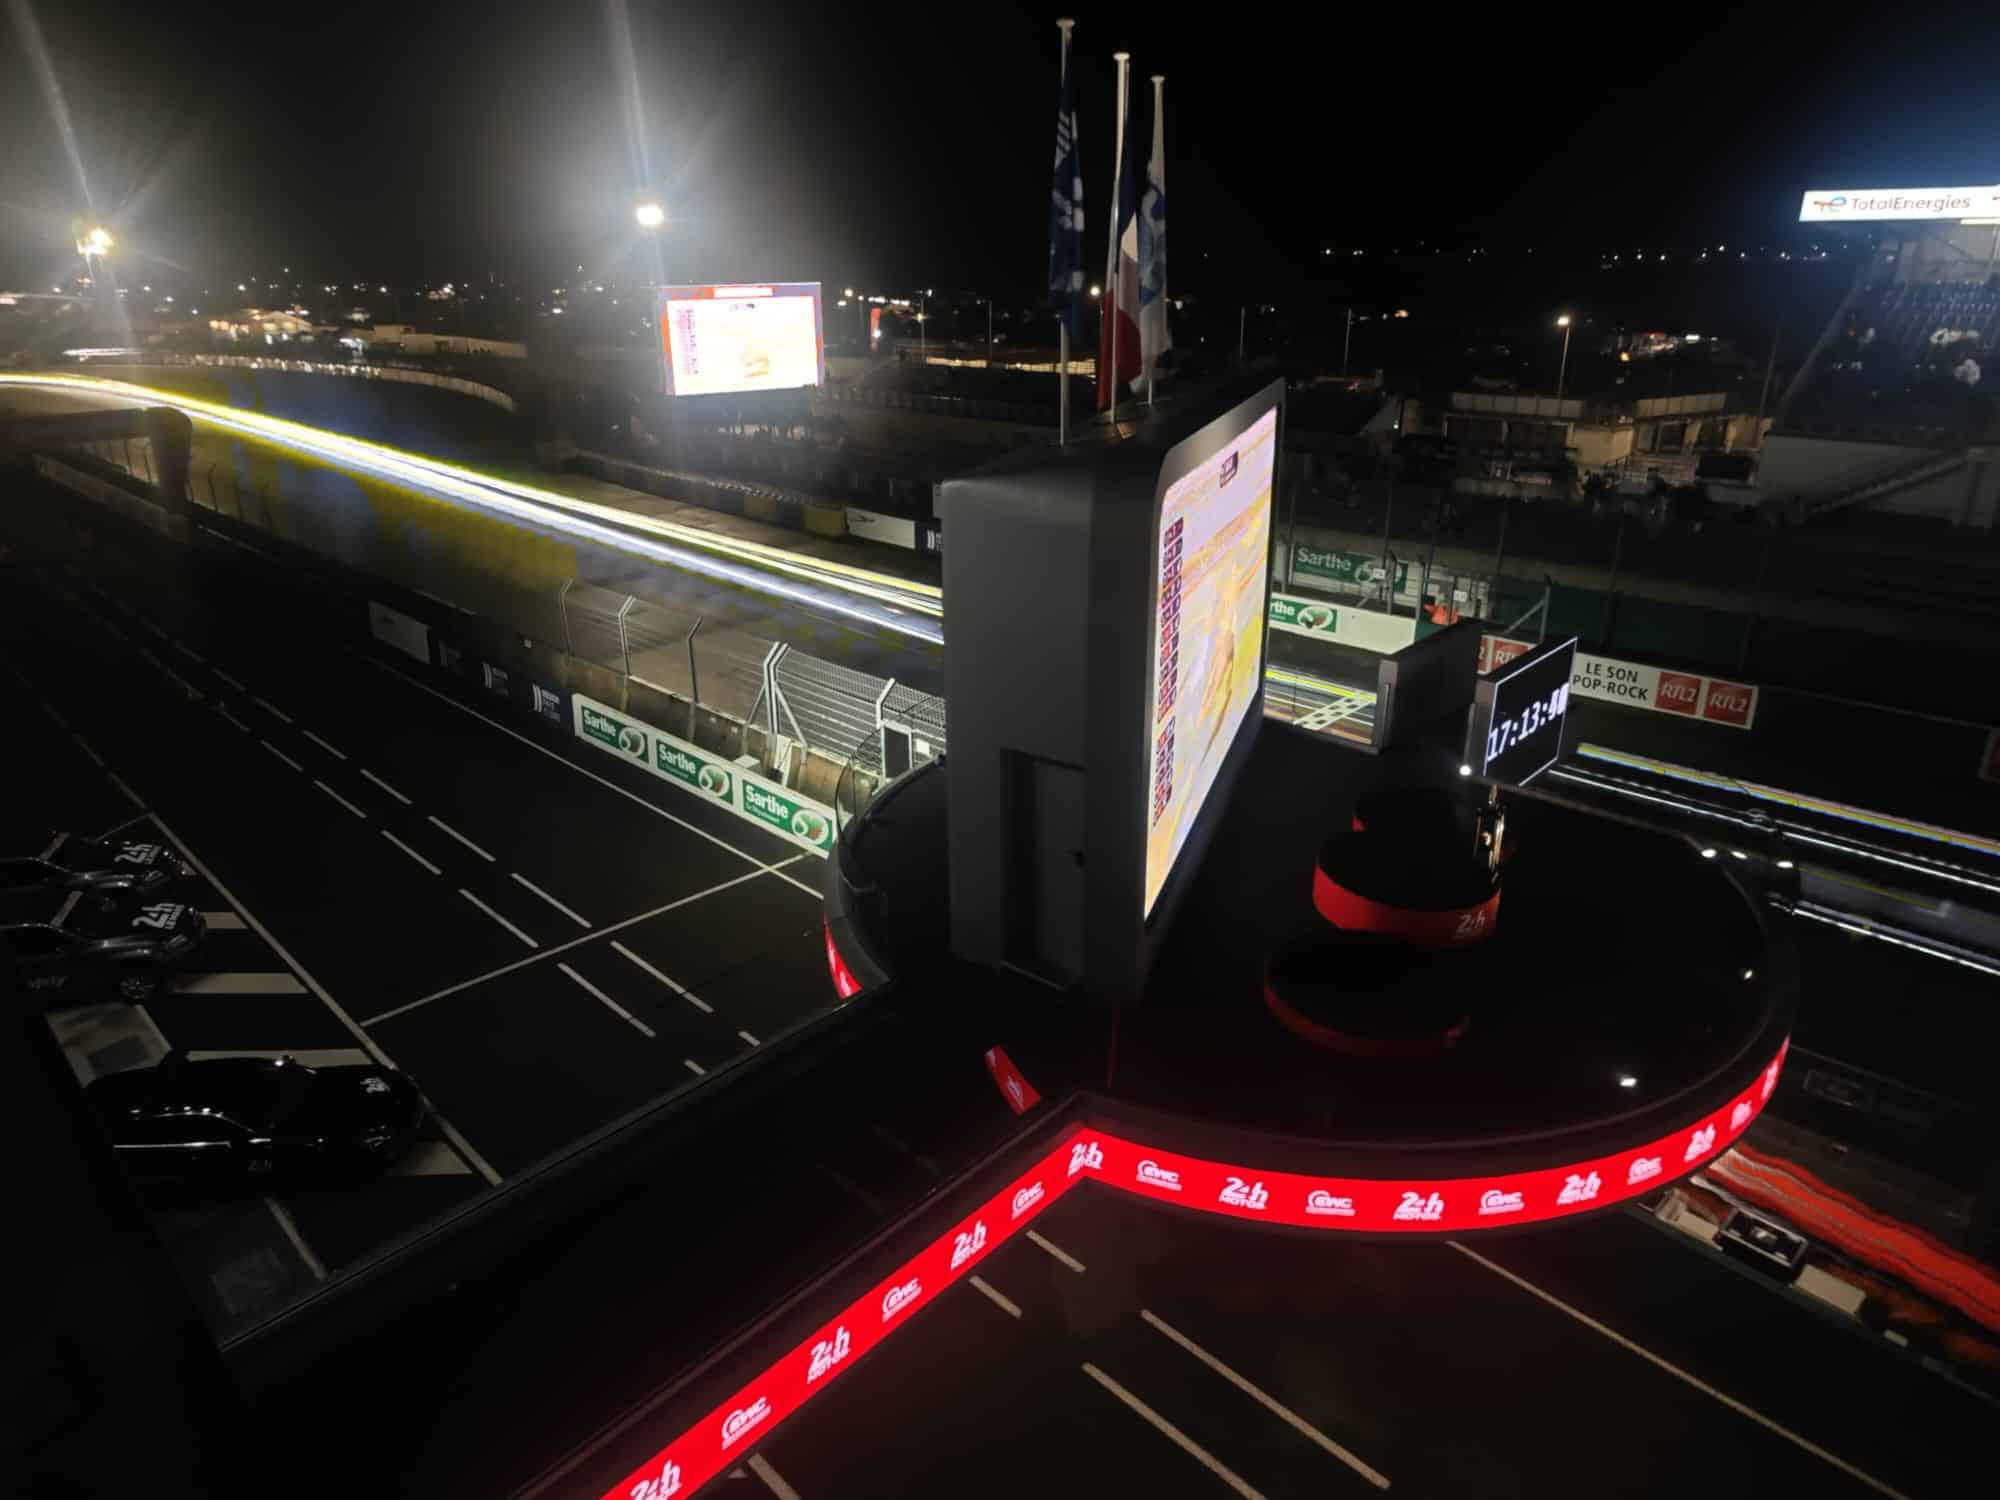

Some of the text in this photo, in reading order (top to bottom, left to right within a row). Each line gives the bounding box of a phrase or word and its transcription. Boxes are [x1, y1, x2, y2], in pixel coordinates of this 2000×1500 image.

[1850, 194, 1971, 212] TotalEnergies
[1297, 547, 1352, 571] Sarthe
[1586, 662, 1638, 683] LE SON
[1573, 674, 1649, 700] POP-ROCK
[1661, 682, 1698, 703] RTL2
[1711, 693, 1748, 713] RTL2
[583, 709, 617, 737] Sarthe
[658, 743, 697, 774] Sarthe
[745, 783, 790, 819] Sarthe
[1221, 1177, 1269, 1202] 24h
[1396, 1191, 1445, 1213] 24h
[808, 1326, 850, 1371] 24h
